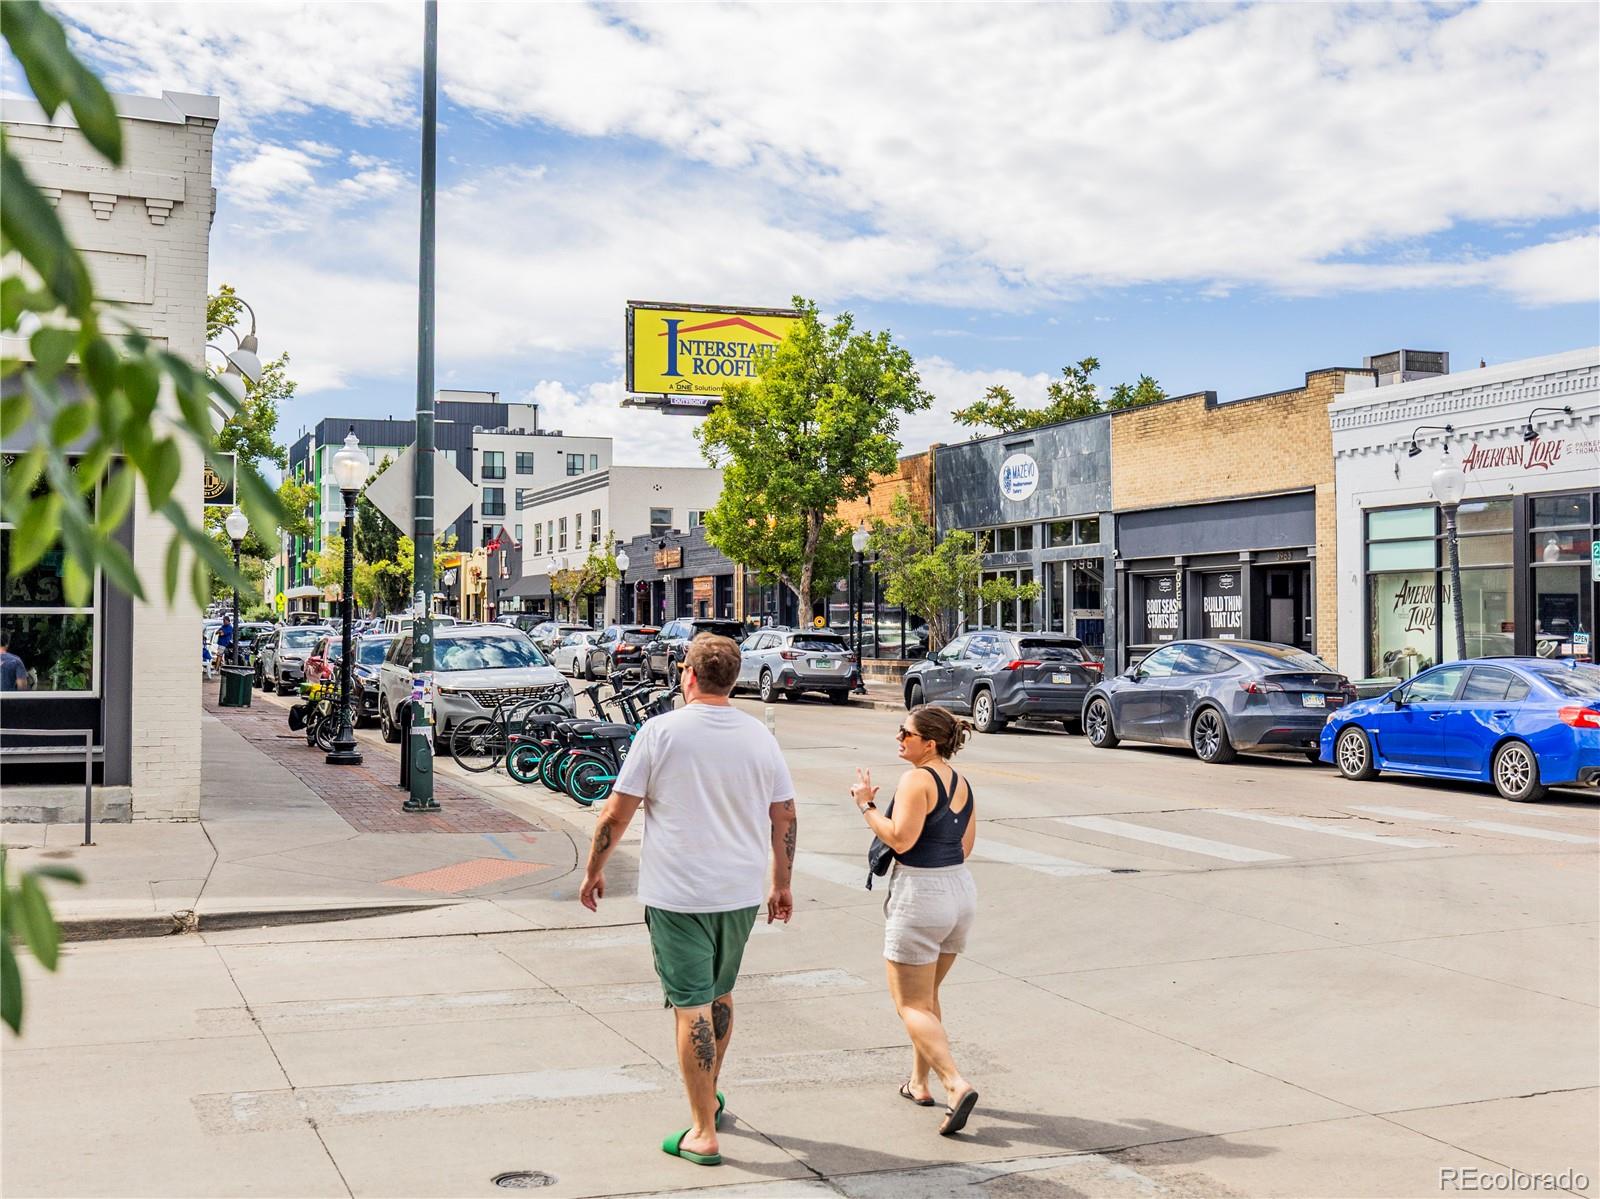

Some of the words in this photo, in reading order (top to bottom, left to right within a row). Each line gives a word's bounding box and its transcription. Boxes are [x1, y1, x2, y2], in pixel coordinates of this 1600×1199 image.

[1462, 443, 1525, 474] AMERICAN
[1524, 438, 1565, 470] LORE
[1203, 596, 1223, 613] BUILD
[1224, 595, 1242, 611] THIN
[1393, 580, 1451, 613] AMERIN
[1146, 599, 1161, 614] BOOT
[1161, 598, 1178, 614] SEAS
[1147, 613, 1169, 629] STARTS
[1210, 612, 1227, 628] THAT
[1574, 634, 1588, 643] OPEN
[617, 744, 628, 761] ve
